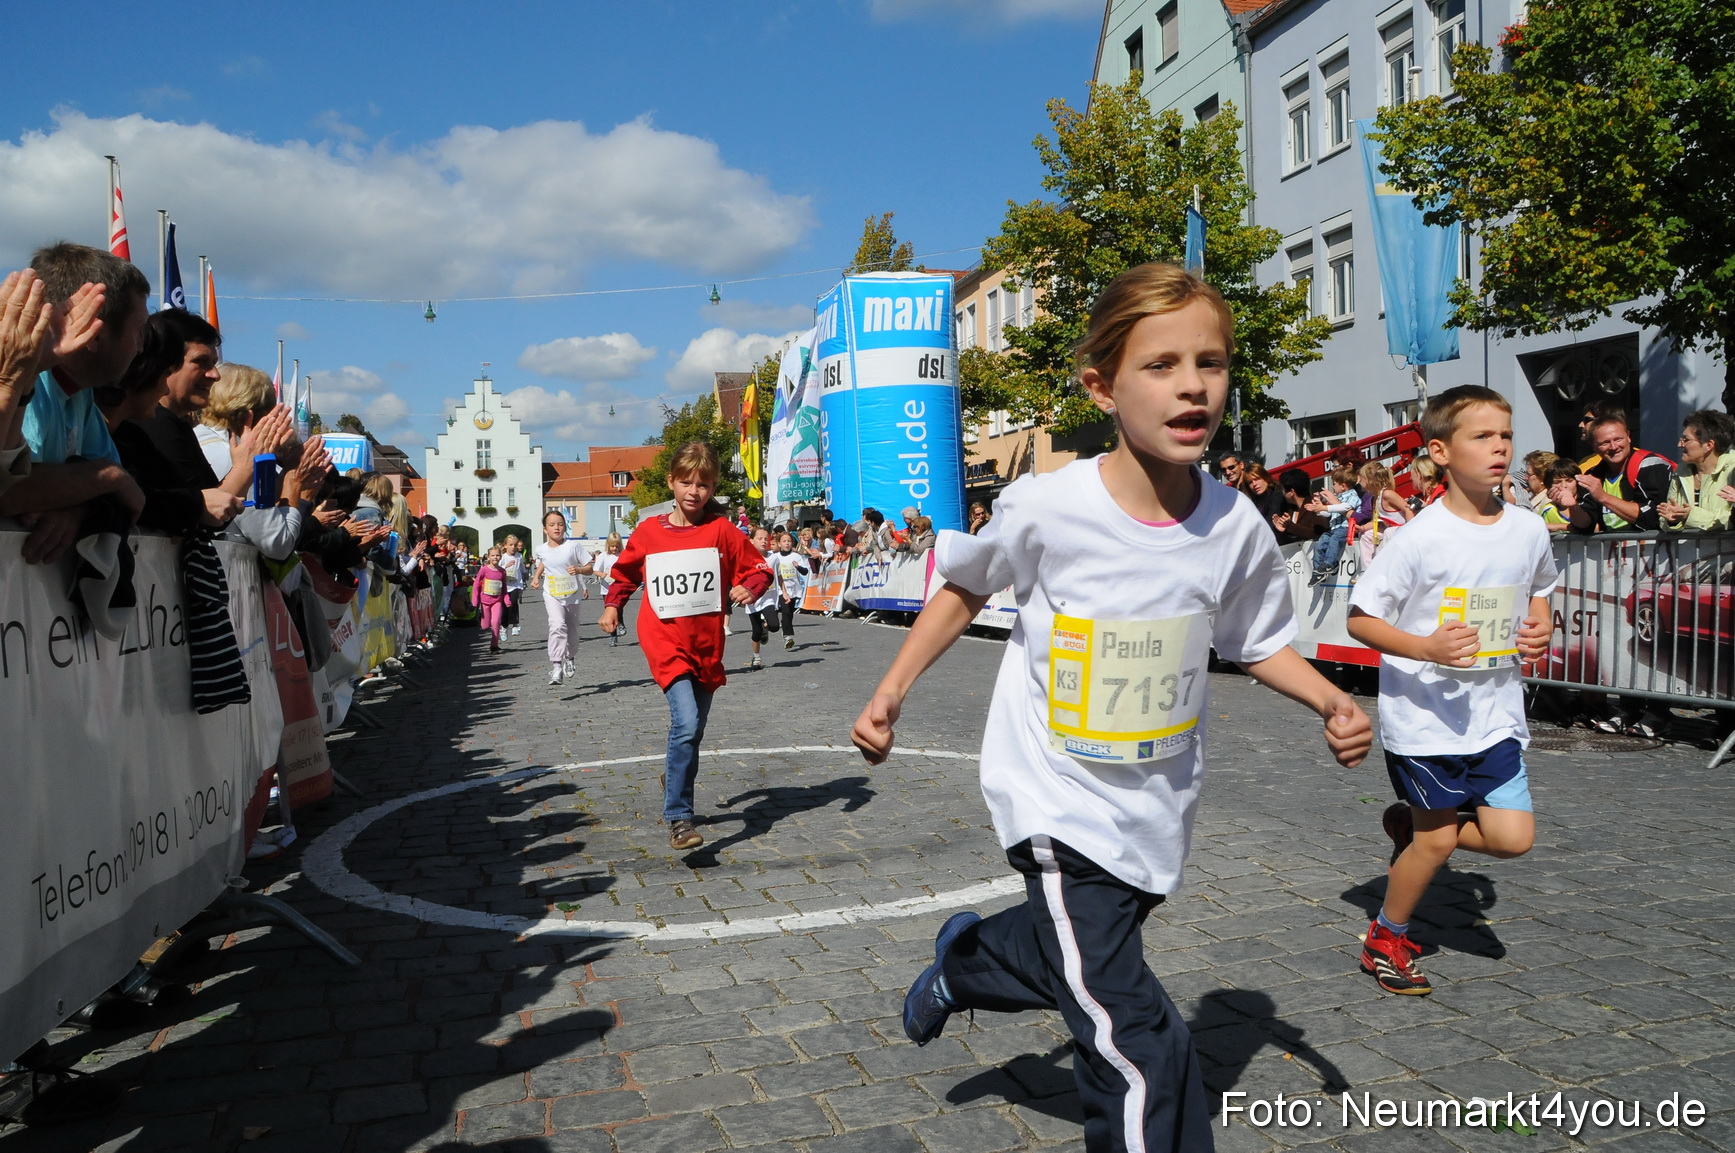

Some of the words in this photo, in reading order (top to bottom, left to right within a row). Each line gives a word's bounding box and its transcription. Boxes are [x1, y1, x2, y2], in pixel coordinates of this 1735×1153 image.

[863, 289, 944, 333] maxi
[824, 360, 841, 388] dsl
[918, 353, 945, 379] dsl
[652, 571, 715, 597] 10372
[1470, 594, 1498, 610] Elisa
[48, 614, 100, 668] ein
[1101, 631, 1163, 659] Paula
[1057, 669, 1078, 690] K3
[1102, 666, 1199, 716] 7137
[1066, 739, 1112, 755] BOCK
